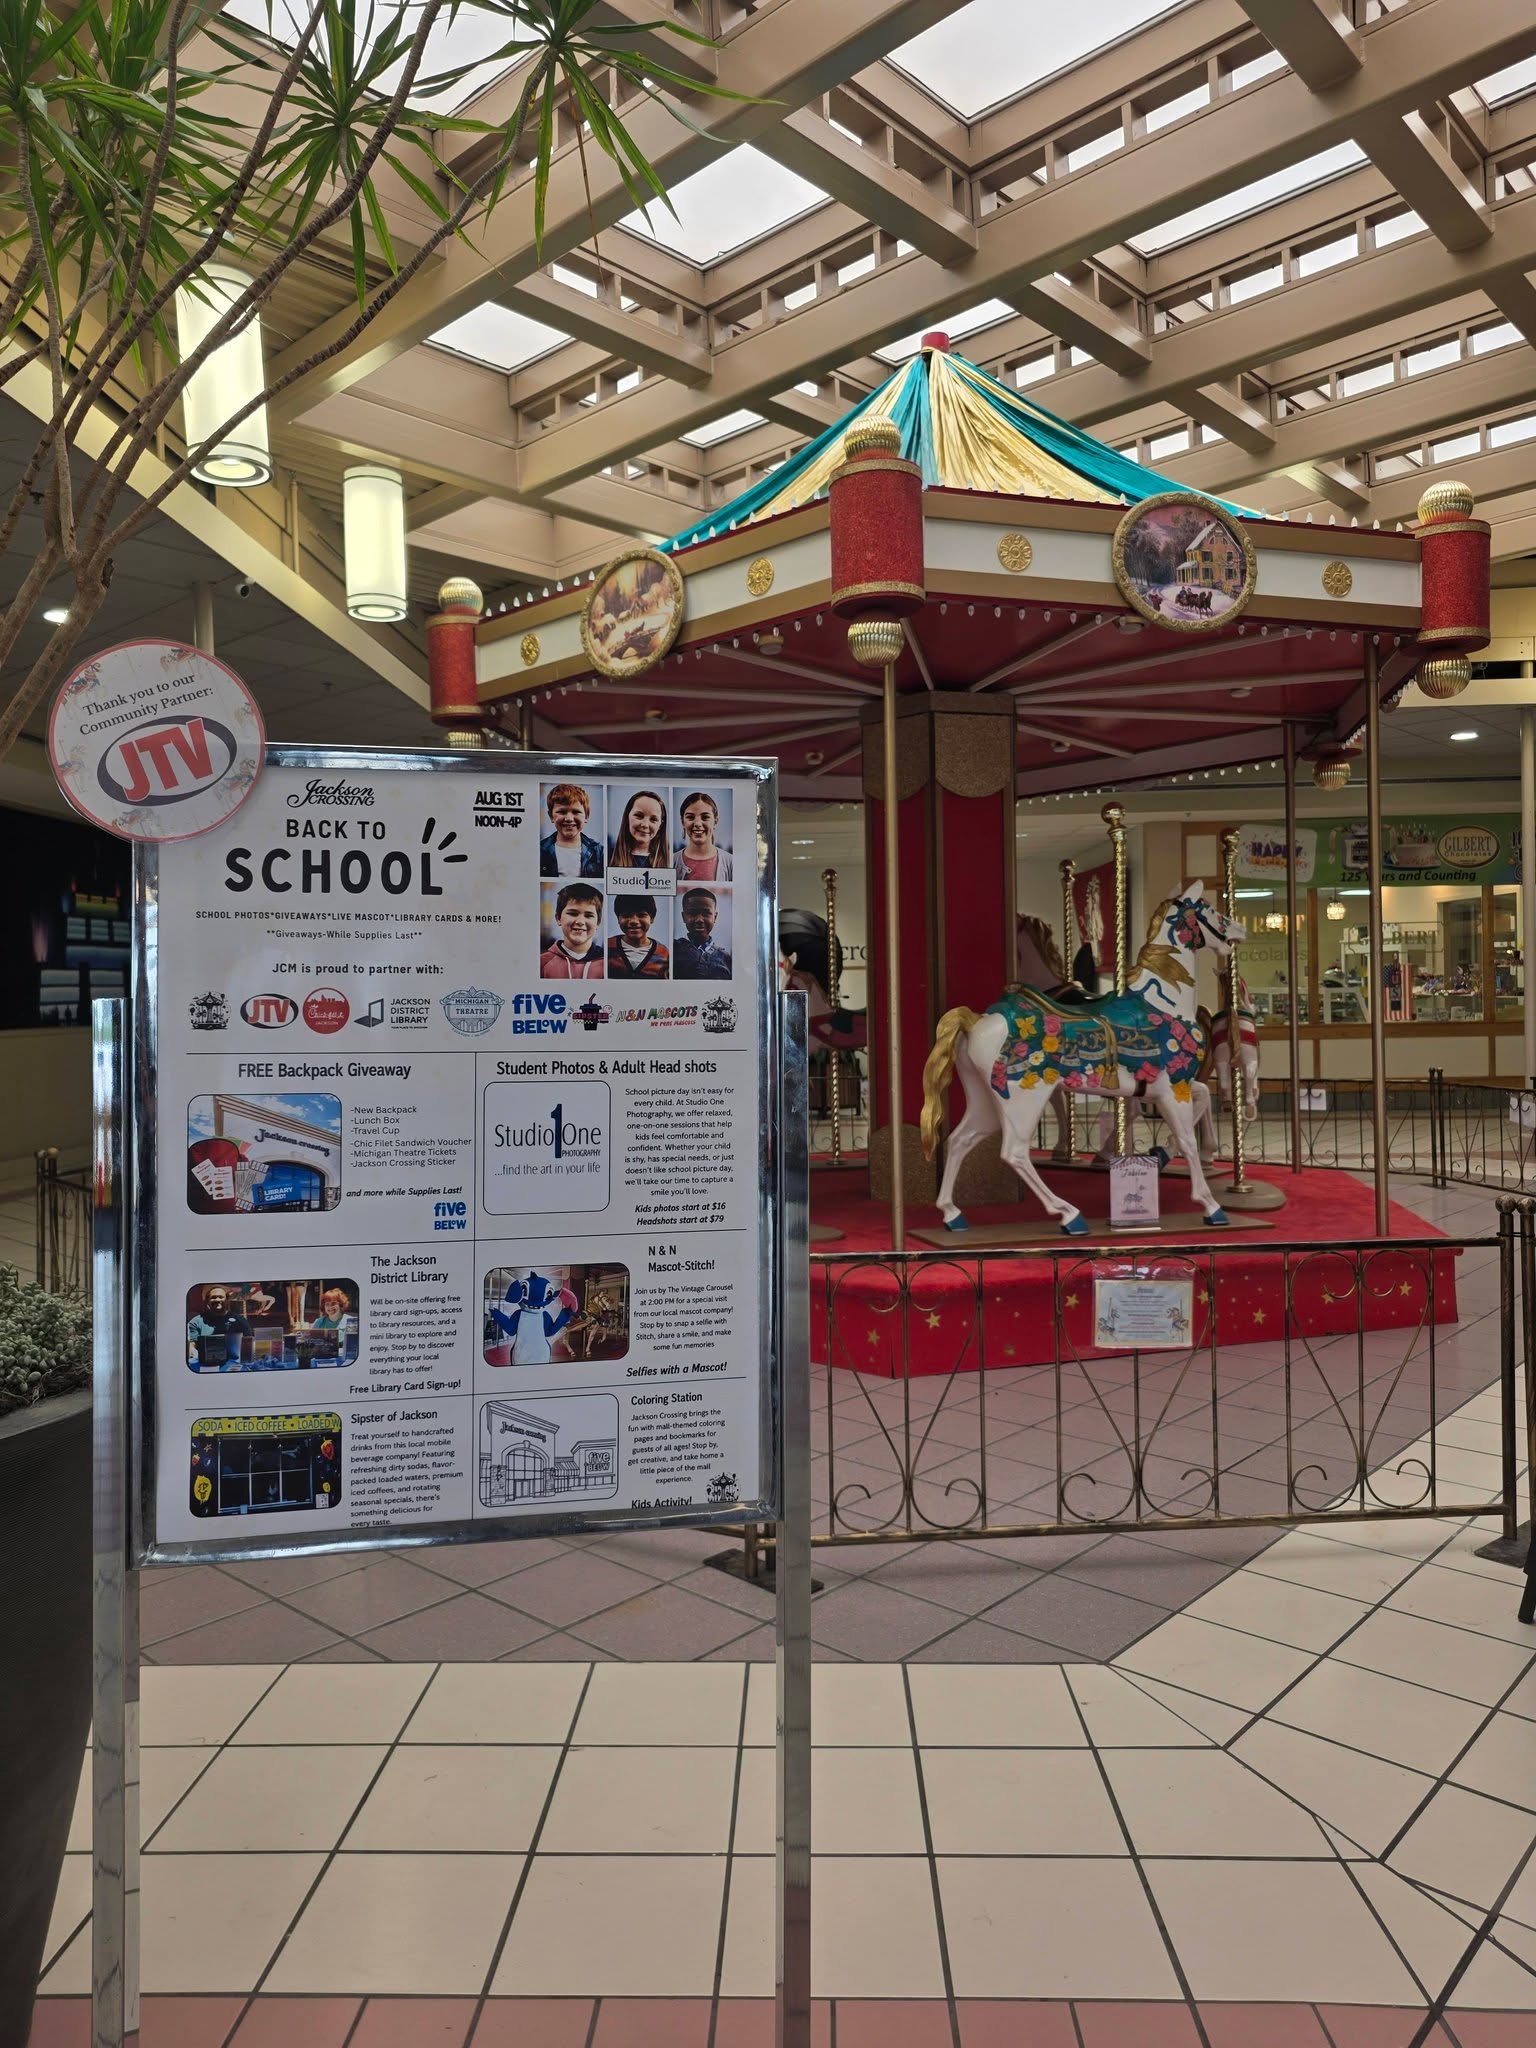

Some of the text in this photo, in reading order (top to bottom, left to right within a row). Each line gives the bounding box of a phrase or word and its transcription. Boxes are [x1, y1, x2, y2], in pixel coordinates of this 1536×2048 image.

[82, 673, 196, 716] Thank you to our
[79, 686, 214, 736] Community Partner:
[118, 717, 213, 802] JTV
[287, 779, 374, 808] Jackson
[308, 794, 375, 806] CROSSING
[475, 791, 523, 807] AUG 1ST
[474, 815, 522, 828] NOON-4P
[286, 819, 385, 840] BACK TO
[1444, 836, 1491, 851] GILBERT
[224, 847, 443, 895] SCHOOL
[1341, 872, 1361, 882] 125
[1398, 870, 1422, 881] and
[1425, 869, 1476, 882] Counting
[196, 911, 231, 919] SCHOOL
[435, 914, 463, 922] CARDS
[475, 915, 501, 923] MORE!
[354, 930, 392, 941] Supplies
[272, 963, 443, 976] JCM is proud to partner with:
[390, 998, 430, 1006] JACKSON
[248, 999, 291, 1024] JTV
[647, 1005, 698, 1020] MASCOTS
[390, 1016, 428, 1024] LIBRARY
[239, 1062, 411, 1081] FREE Backpack Giveaway
[496, 1059, 717, 1075] Student Photos & Adult Head shots
[651, 1088, 676, 1097] picture
[677, 1088, 690, 1096] day
[707, 1088, 723, 1096] easy
[376, 1105, 417, 1115] Backpack
[383, 1116, 400, 1124] Box
[382, 1127, 400, 1135] Cup
[395, 1139, 435, 1147] Sandwich
[437, 1138, 472, 1146] Voucher
[428, 1148, 457, 1156] Tickets
[389, 1158, 426, 1168] Crossing
[427, 1158, 456, 1166] Sticker
[523, 1164, 538, 1175] the
[540, 1164, 552, 1174] art
[554, 1165, 563, 1174] in
[565, 1164, 585, 1175] your
[587, 1161, 601, 1173] life
[264, 1187, 293, 1196] LIBRARY
[346, 1189, 362, 1197] and
[385, 1188, 406, 1196] while
[408, 1187, 441, 1197] Supplies
[443, 1186, 462, 1194] Last!
[635, 1204, 652, 1213] Kids
[653, 1204, 680, 1214] photos
[712, 1202, 726, 1211] $16
[636, 1217, 677, 1226] Headshots
[679, 1216, 698, 1224] start
[709, 1214, 724, 1223] $79
[648, 1245, 676, 1256] N & N
[370, 1254, 436, 1267] The Jackson
[648, 1259, 715, 1272] Mascot-Stitch!
[371, 1271, 449, 1284] District Library
[658, 1287, 666, 1295] by
[706, 1283, 733, 1291] Carousel
[626, 1366, 658, 1377] Selfies
[660, 1364, 680, 1375] with
[691, 1361, 727, 1373] Mascot!
[350, 1379, 461, 1394] Free Library Card Sign-up!
[631, 1392, 702, 1406] Coloring Station
[351, 1410, 438, 1426] Sipster of Jackson
[198, 1421, 223, 1432] SODA
[234, 1420, 254, 1431] ICED
[256, 1420, 287, 1431] COFFEE
[297, 1419, 330, 1430] LOADED
[631, 1496, 692, 1509] Kids Activity!
